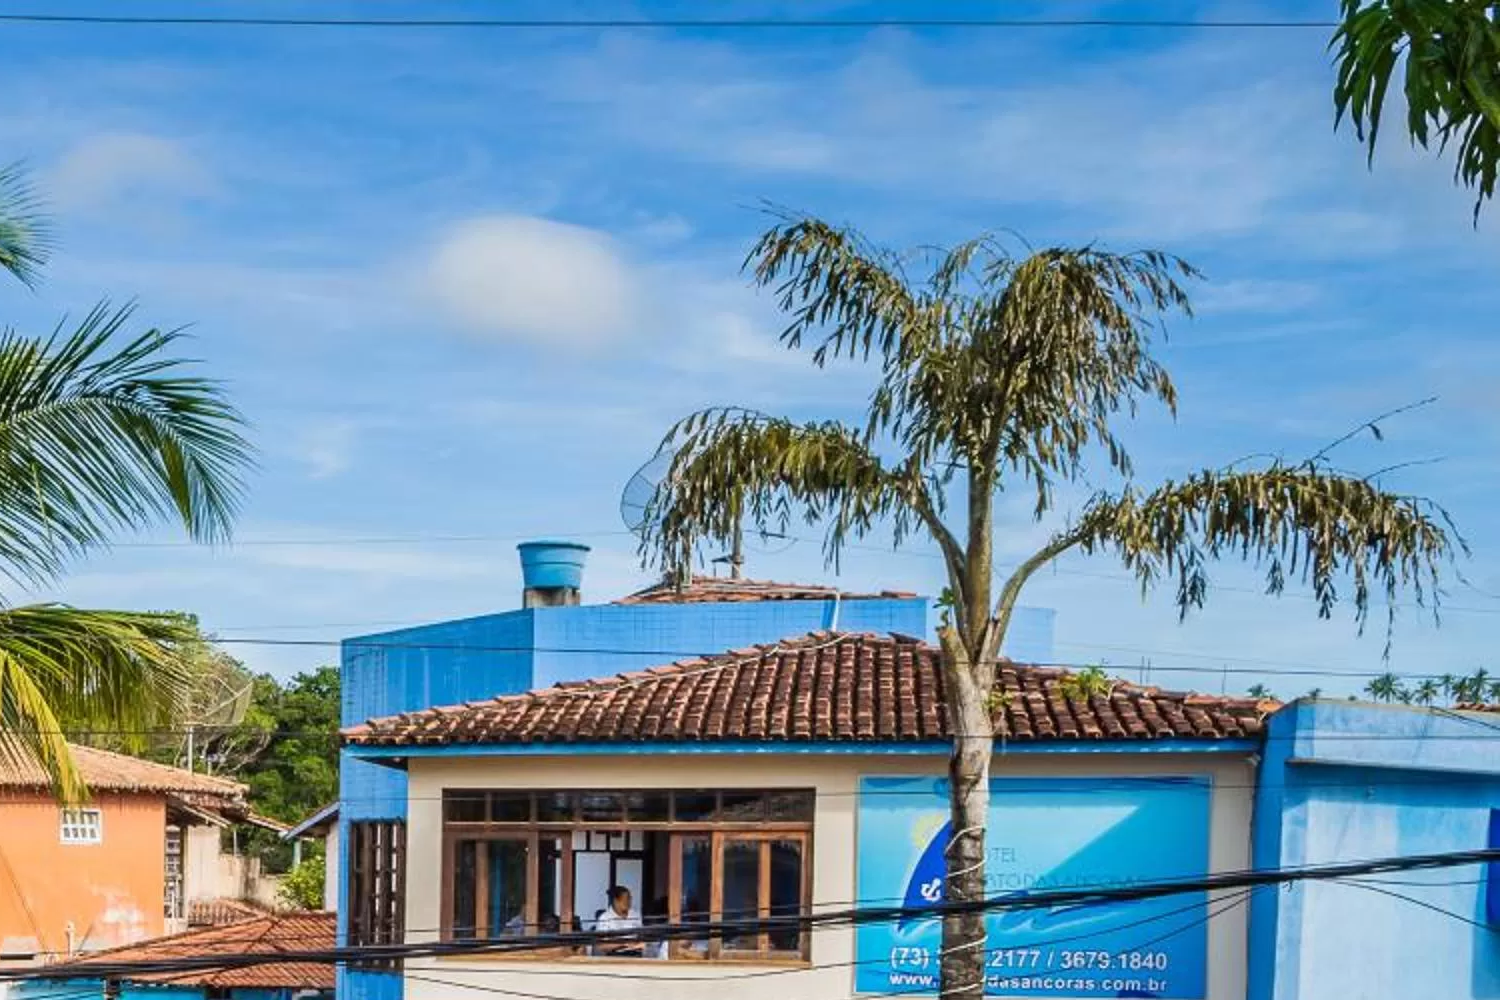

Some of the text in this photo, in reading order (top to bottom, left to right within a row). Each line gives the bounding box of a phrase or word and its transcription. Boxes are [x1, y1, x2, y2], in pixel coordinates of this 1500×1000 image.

[985, 847, 1016, 863] TEL
[891, 947, 930, 969] (73)
[1060, 951, 1168, 970] 3679.1840
